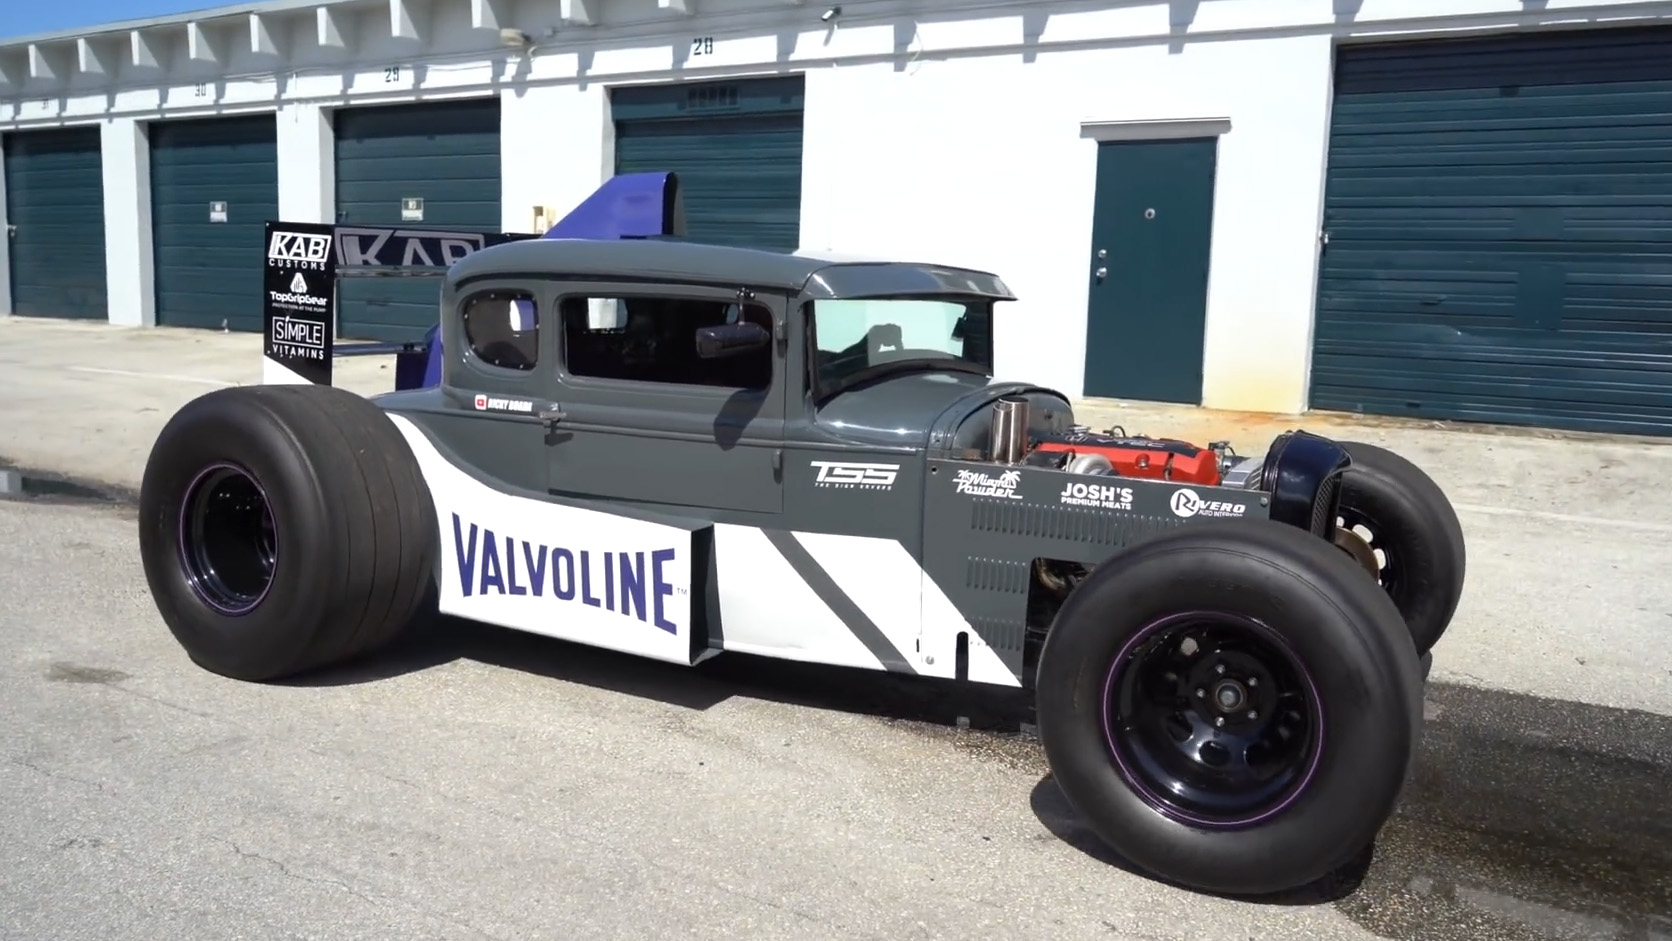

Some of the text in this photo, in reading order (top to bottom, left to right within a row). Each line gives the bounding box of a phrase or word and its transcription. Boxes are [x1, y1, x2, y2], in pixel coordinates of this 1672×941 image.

[693, 37, 713, 55] 28
[384, 66, 399, 82] 29
[270, 233, 327, 260] KAB
[268, 258, 326, 271] CUSTOMS
[269, 290, 328, 307] TopGripGear
[272, 344, 324, 360] VITAMINS
[810, 461, 900, 485] TSS
[1060, 482, 1133, 503] JOSH'S
[1060, 496, 1132, 510] PREMIUM MEATS
[1198, 509, 1213, 517] AUTO
[452, 511, 677, 636] VALVOLINE
